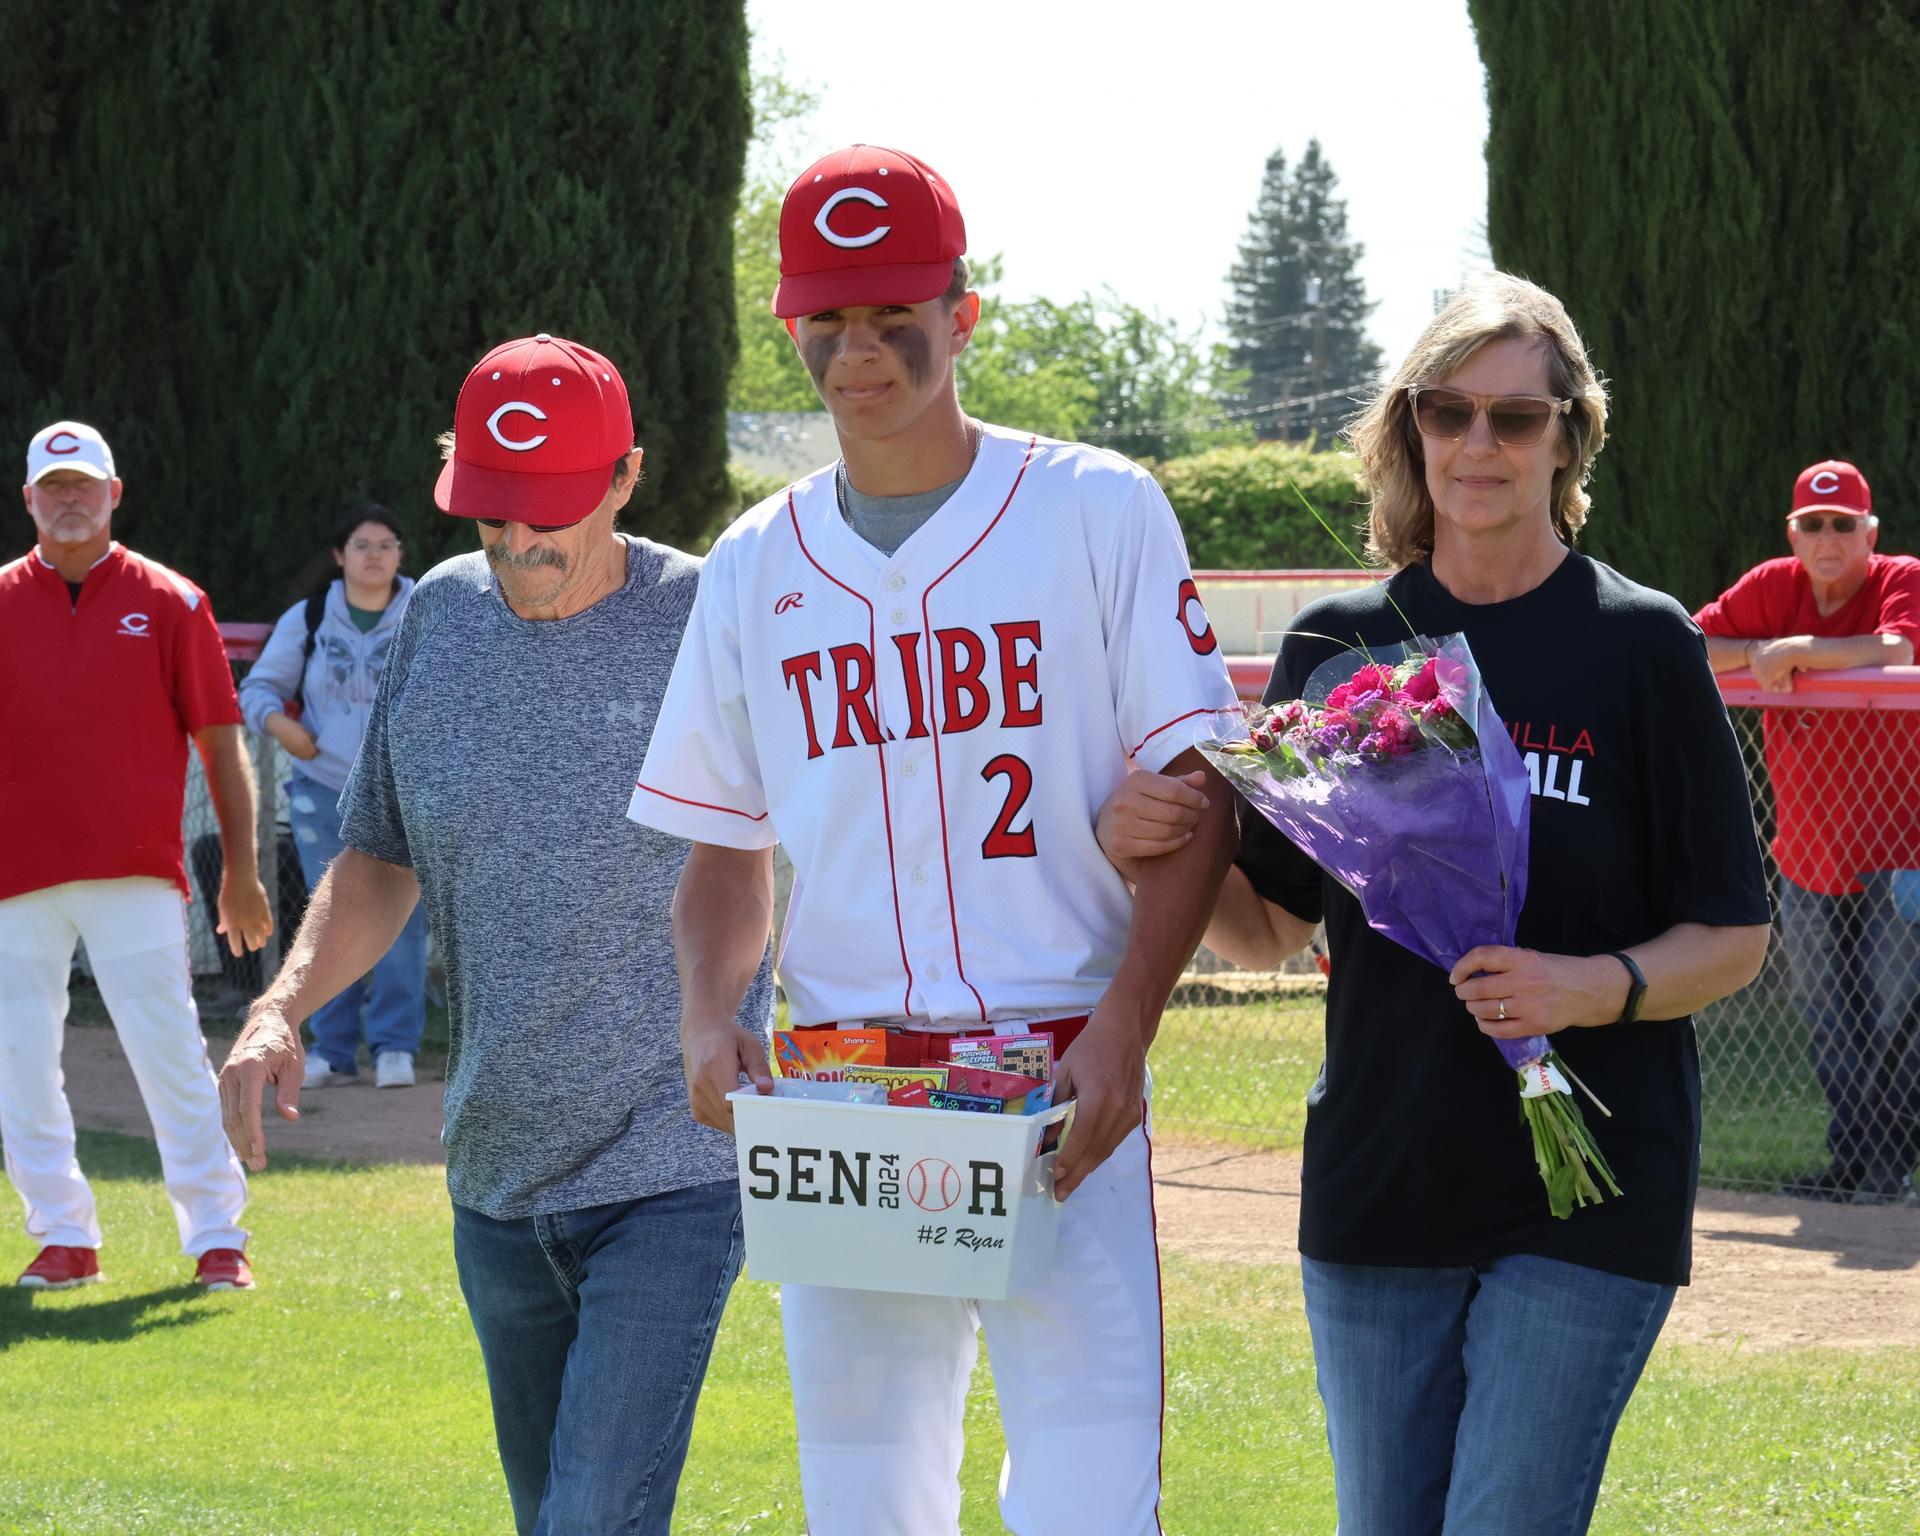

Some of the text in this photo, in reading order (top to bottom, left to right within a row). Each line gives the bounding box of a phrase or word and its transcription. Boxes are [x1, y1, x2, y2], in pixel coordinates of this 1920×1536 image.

[813, 187, 891, 250] C
[486, 401, 548, 452] C
[45, 431, 80, 455] C
[1810, 471, 1840, 494] C
[120, 612, 149, 632] C
[781, 620, 1043, 760] TRIBE
[1504, 721, 1595, 757] ILLA
[981, 753, 1038, 860] 2
[843, 1037, 865, 1045] Share
[959, 1050, 991, 1058] CROSSWORD
[969, 1055, 997, 1064] EXPRESS
[878, 1153, 900, 1209] 2024
[918, 1225, 1005, 1252] #2 Ryan
